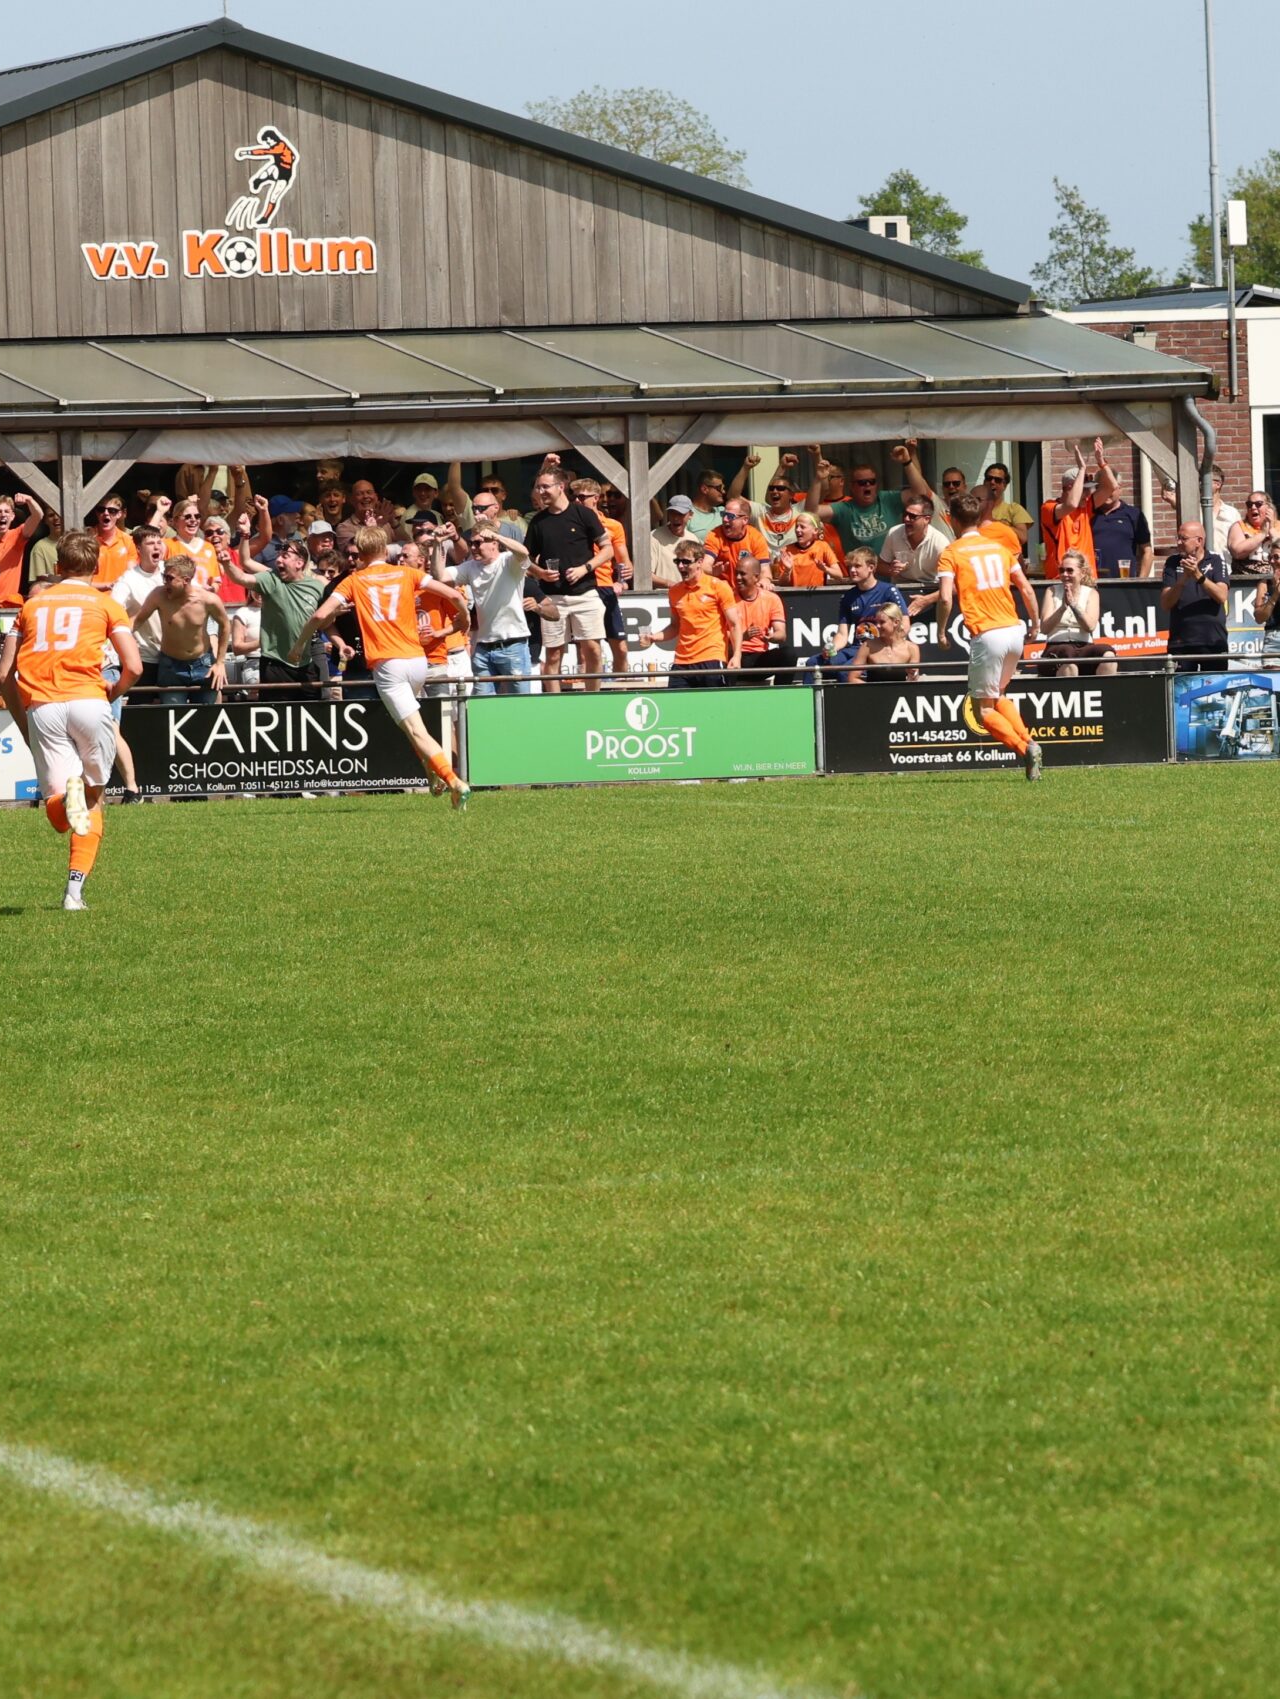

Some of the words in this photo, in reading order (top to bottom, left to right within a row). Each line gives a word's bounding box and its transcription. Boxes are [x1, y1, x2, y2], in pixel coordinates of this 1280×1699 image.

[81, 241, 169, 279] v.v.
[970, 554, 1004, 590] 10
[367, 583, 400, 622] 17
[32, 606, 82, 652] 19
[168, 703, 369, 756] KARINS
[889, 729, 967, 743] 0511-454250
[1060, 726, 1069, 737] &
[1072, 725, 1104, 736] DINE
[756, 762, 772, 770] BIER
[786, 762, 807, 770] MEER
[889, 751, 953, 764] Voorstraat
[956, 751, 971, 762] 66
[975, 749, 1016, 761] Kollum
[169, 758, 368, 780] SCHOONHEIDSSALON
[628, 767, 660, 775] KOLLUM
[146, 784, 161, 793] 15a
[168, 783, 202, 793] 9291CA
[206, 782, 236, 791] Kollum
[240, 780, 300, 790] T:0511-451215
